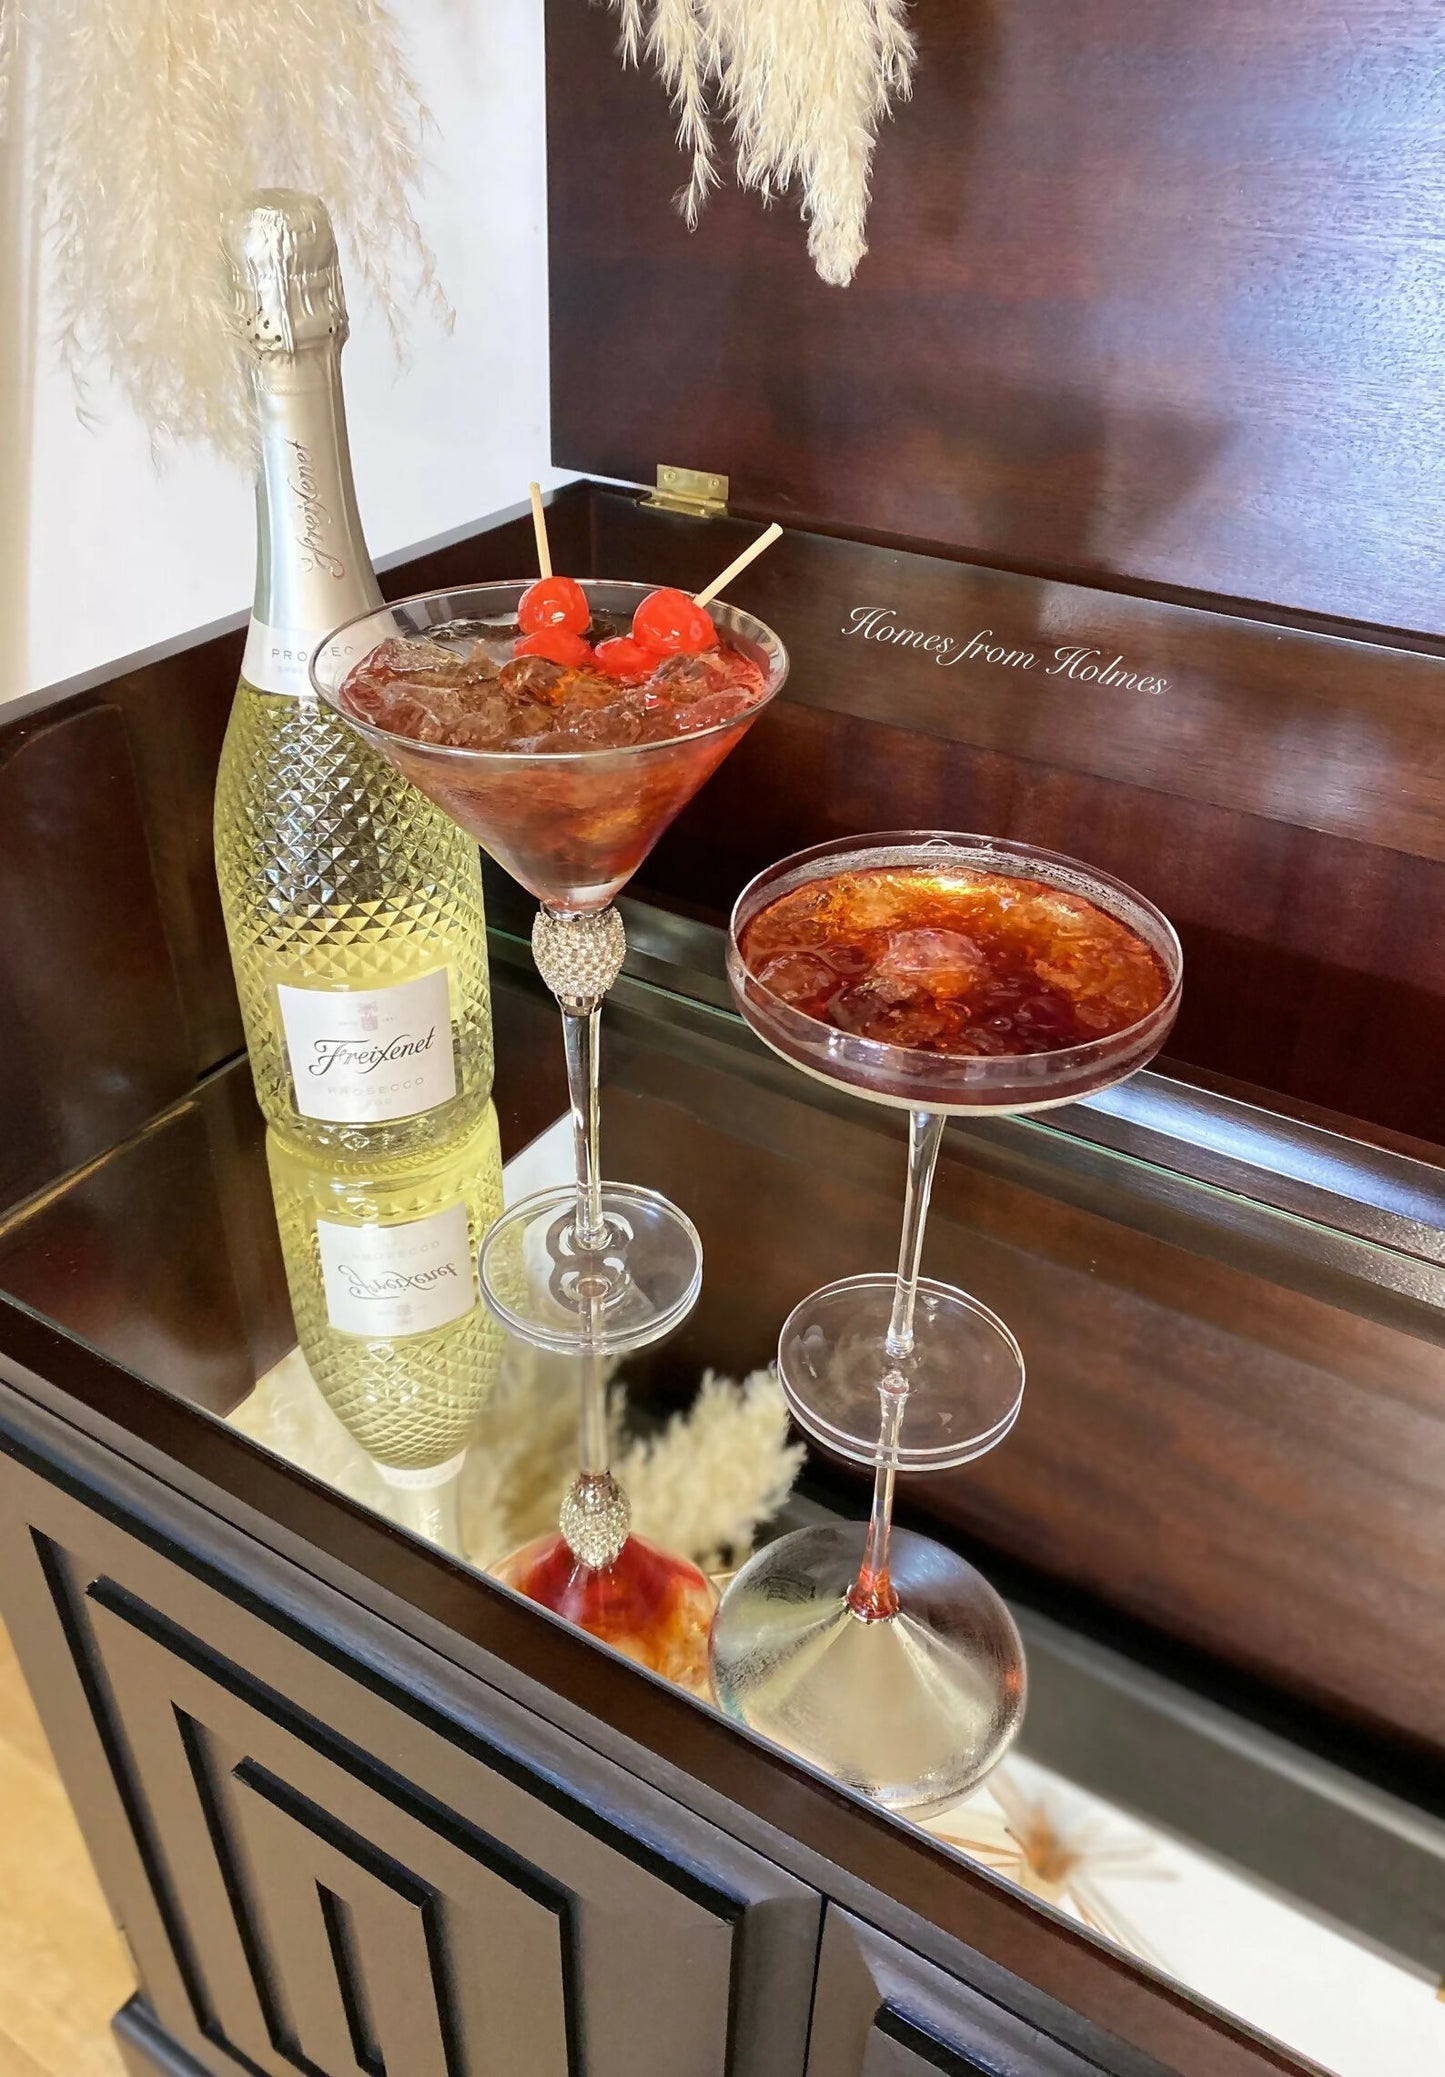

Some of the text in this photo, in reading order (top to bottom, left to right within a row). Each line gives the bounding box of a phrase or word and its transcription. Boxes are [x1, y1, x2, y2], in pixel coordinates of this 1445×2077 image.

[284, 438, 345, 580] Freixenet
[271, 645, 355, 662] PROEC
[841, 606, 1172, 695] Homes from Holmes
[308, 1025, 436, 1076] Freixenet
